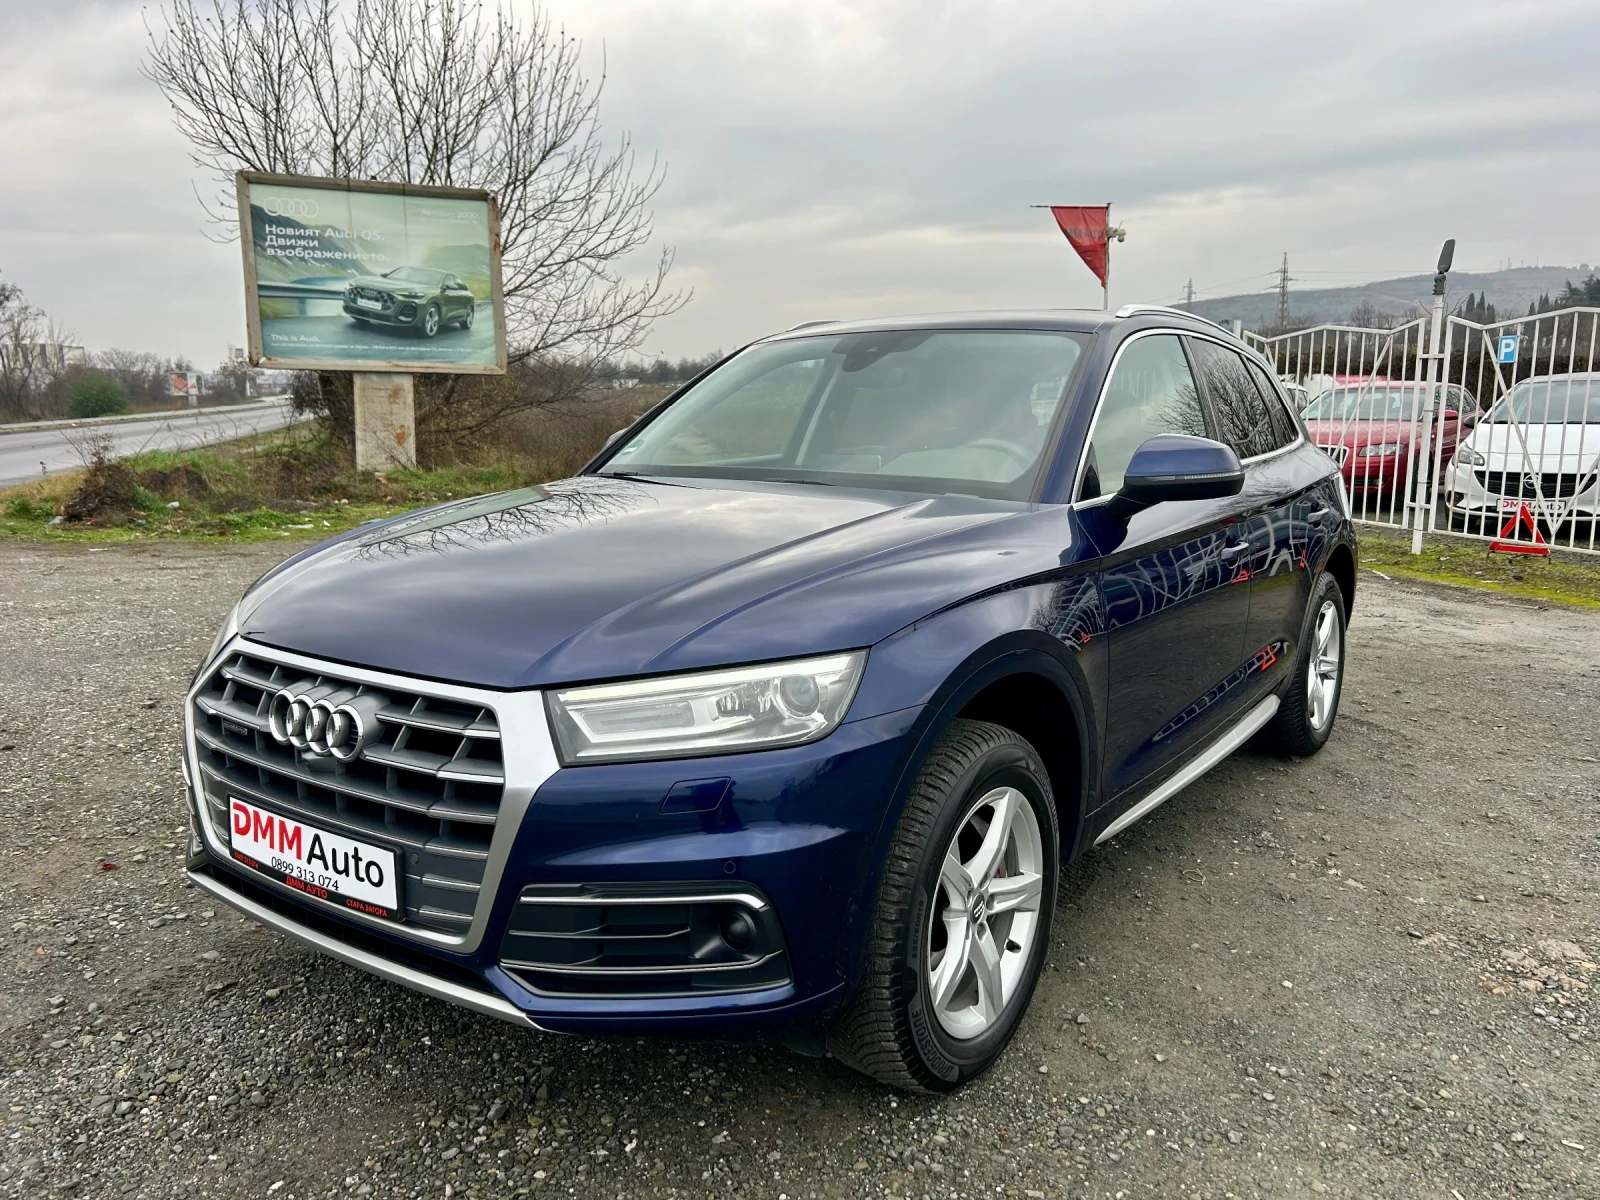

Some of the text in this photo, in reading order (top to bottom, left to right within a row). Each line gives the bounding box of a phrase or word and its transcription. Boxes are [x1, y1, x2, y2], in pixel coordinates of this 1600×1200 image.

[265, 224, 320, 237] Новият
[325, 228, 357, 239] Audi
[265, 235, 319, 248] Движи
[267, 247, 389, 262] въображението.
[1500, 339, 1515, 360] P
[271, 856, 340, 892] 0899 313 074
[286, 875, 328, 899] ДММ АУТО
[345, 898, 388, 917] СТАРА ЗАГОРА
[911, 1007, 954, 1079] BRIDGESTONE
